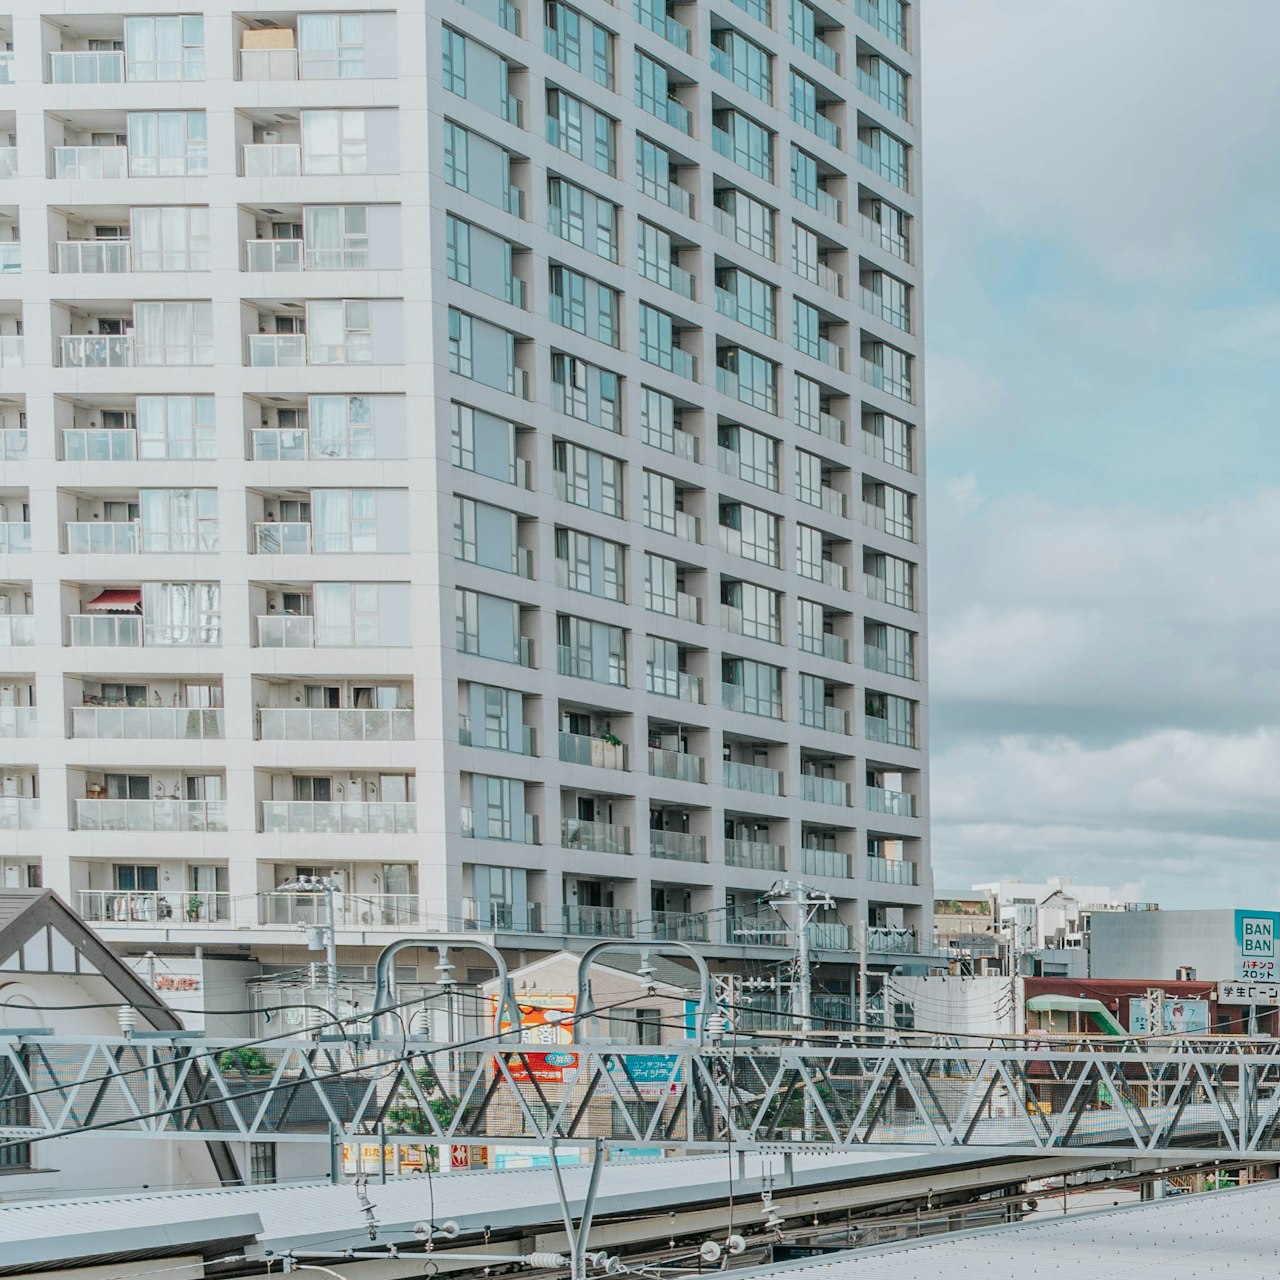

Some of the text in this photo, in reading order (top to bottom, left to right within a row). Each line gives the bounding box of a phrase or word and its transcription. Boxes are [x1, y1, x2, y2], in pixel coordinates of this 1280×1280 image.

[1245, 923, 1271, 936] BAN
[1245, 939, 1271, 951] BAN
[1242, 961, 1274, 970] パチンコ
[1242, 970, 1274, 979] スロット
[1223, 986, 1278, 998] 学生ローン
